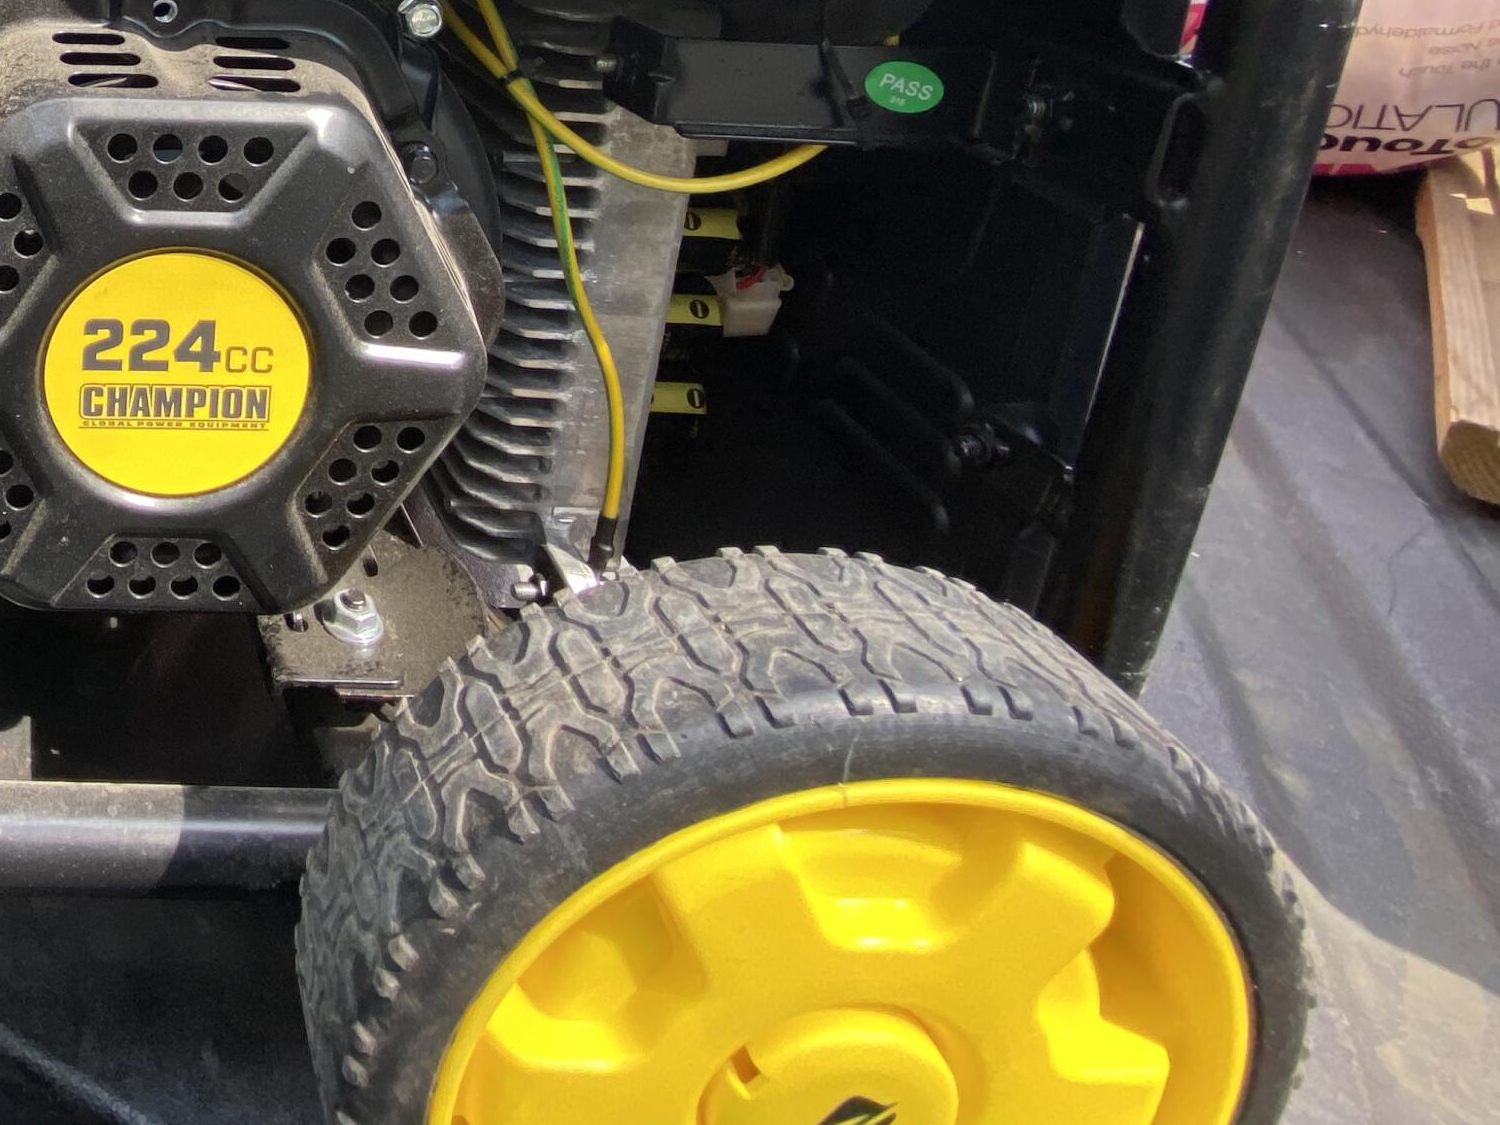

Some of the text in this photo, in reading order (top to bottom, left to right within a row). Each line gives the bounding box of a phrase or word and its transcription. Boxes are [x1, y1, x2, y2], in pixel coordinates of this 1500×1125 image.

[879, 73, 934, 101] PASS
[81, 384, 270, 421] CHAMPION
[82, 420, 133, 428] GLOBAL
[188, 422, 267, 430] EQUIPMENT
